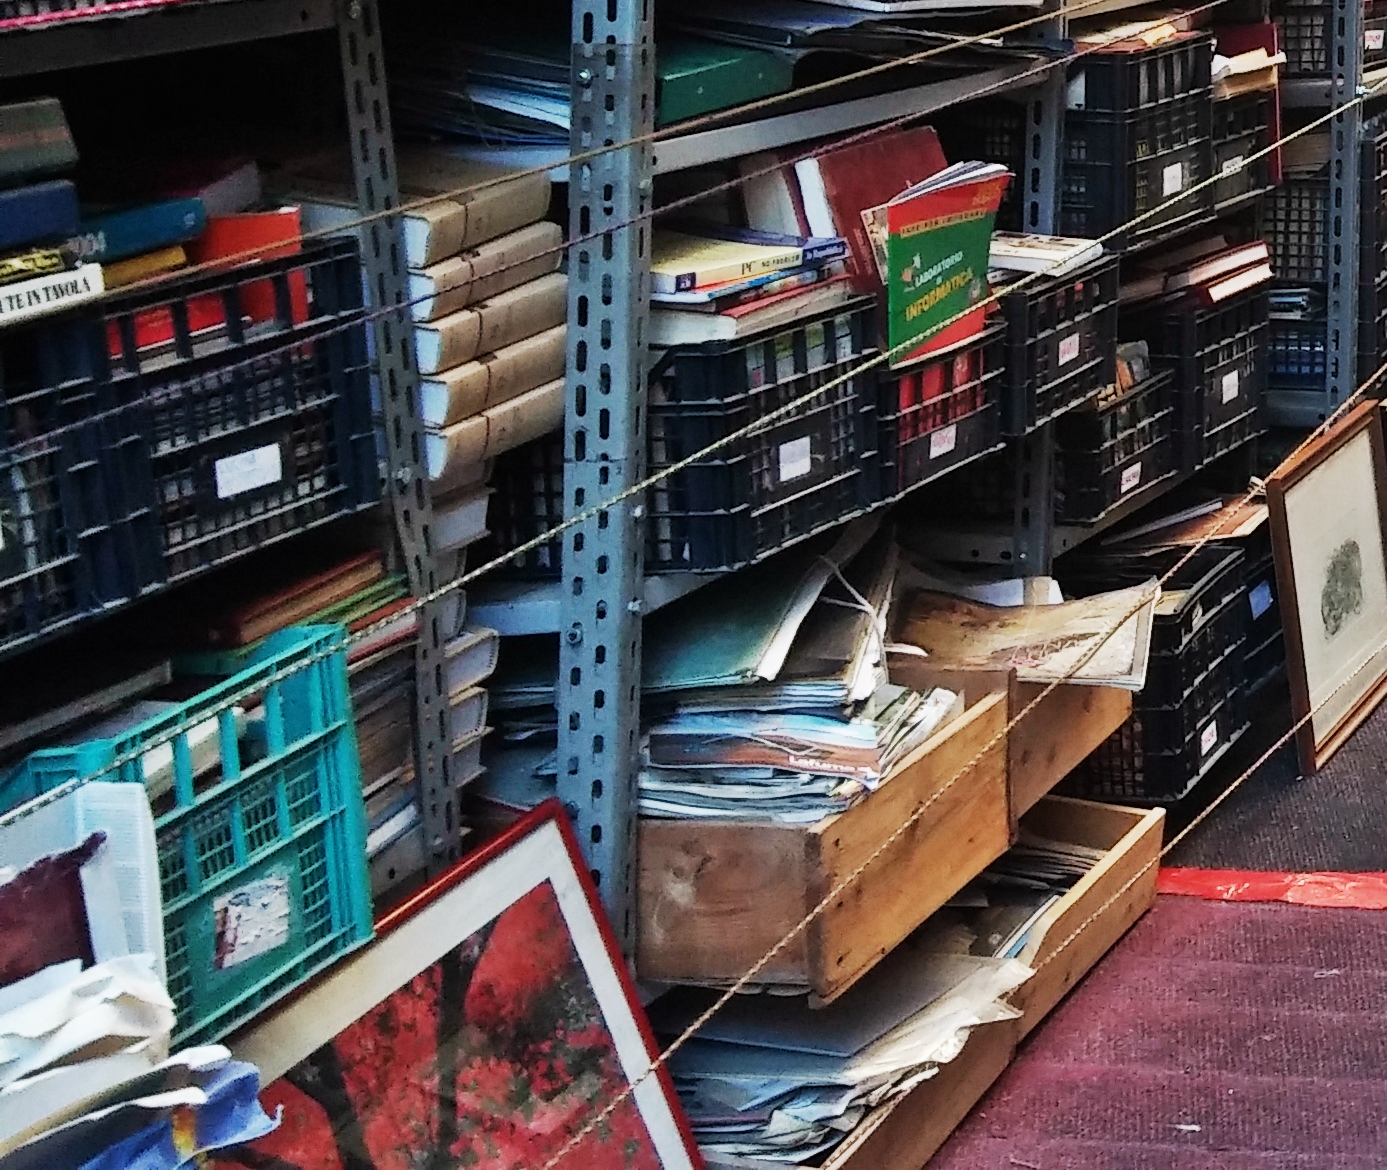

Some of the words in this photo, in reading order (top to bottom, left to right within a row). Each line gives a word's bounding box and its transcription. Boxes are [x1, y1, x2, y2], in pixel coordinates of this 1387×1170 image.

[915, 250, 964, 288] LABORATORIO
[42, 276, 91, 302] TAVOLA
[905, 266, 974, 322] INFORMATICA
